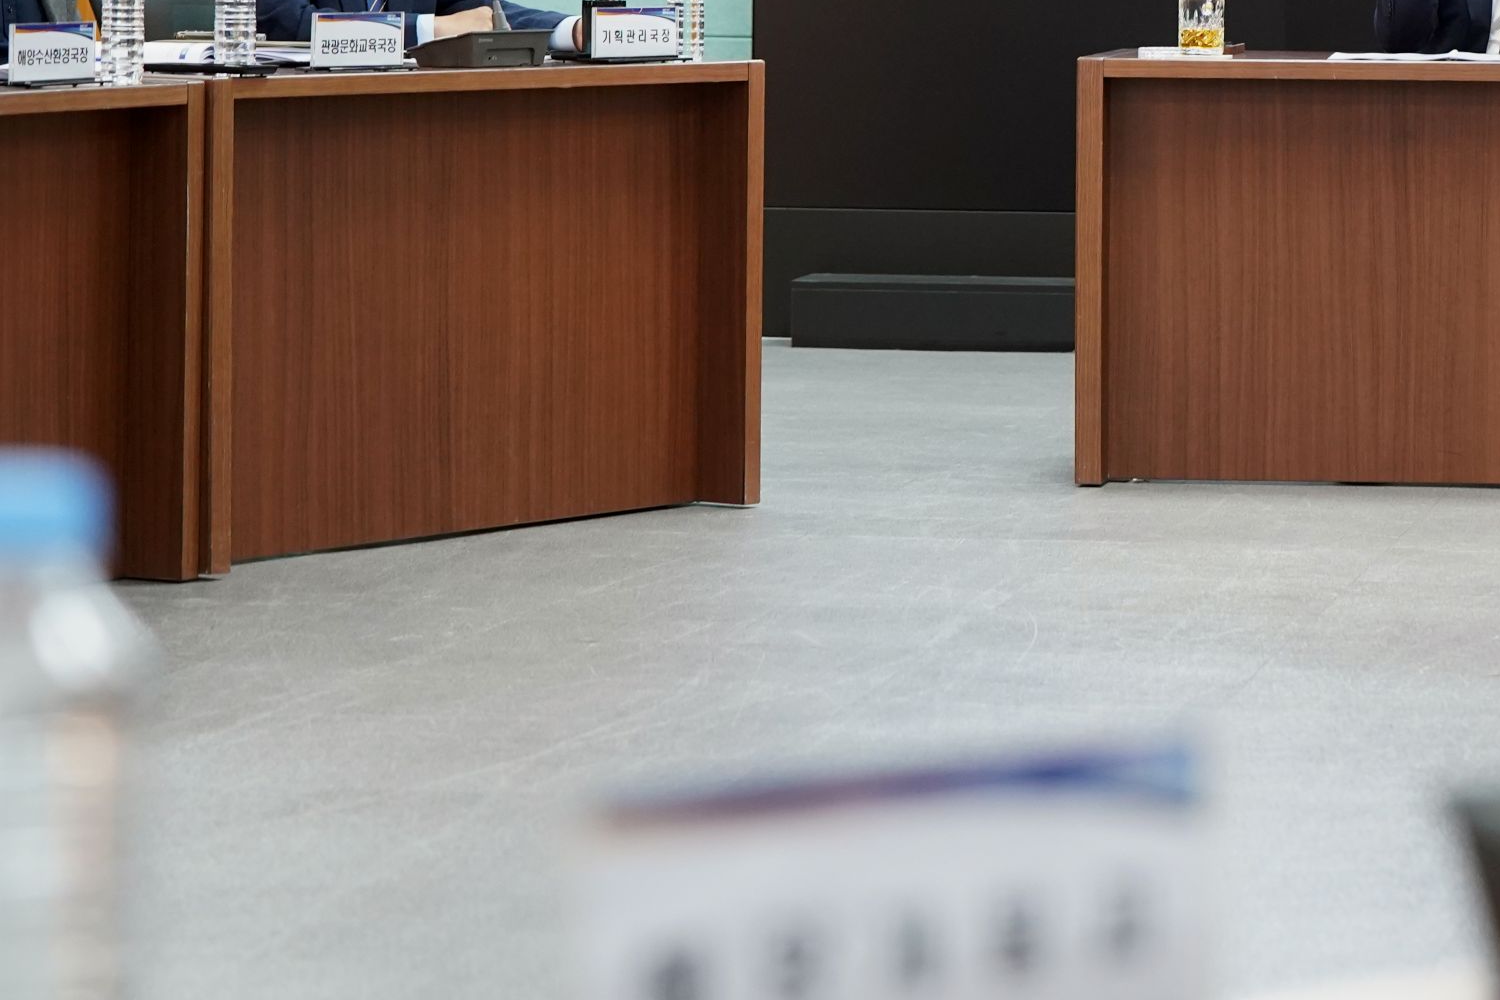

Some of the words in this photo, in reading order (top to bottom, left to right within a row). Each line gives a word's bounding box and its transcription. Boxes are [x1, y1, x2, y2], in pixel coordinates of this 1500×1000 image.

[602, 28, 670, 44] 기획관리국장
[321, 38, 397, 54] 관광문화교육국장
[17, 47, 89, 66] 해양수산환경국장
